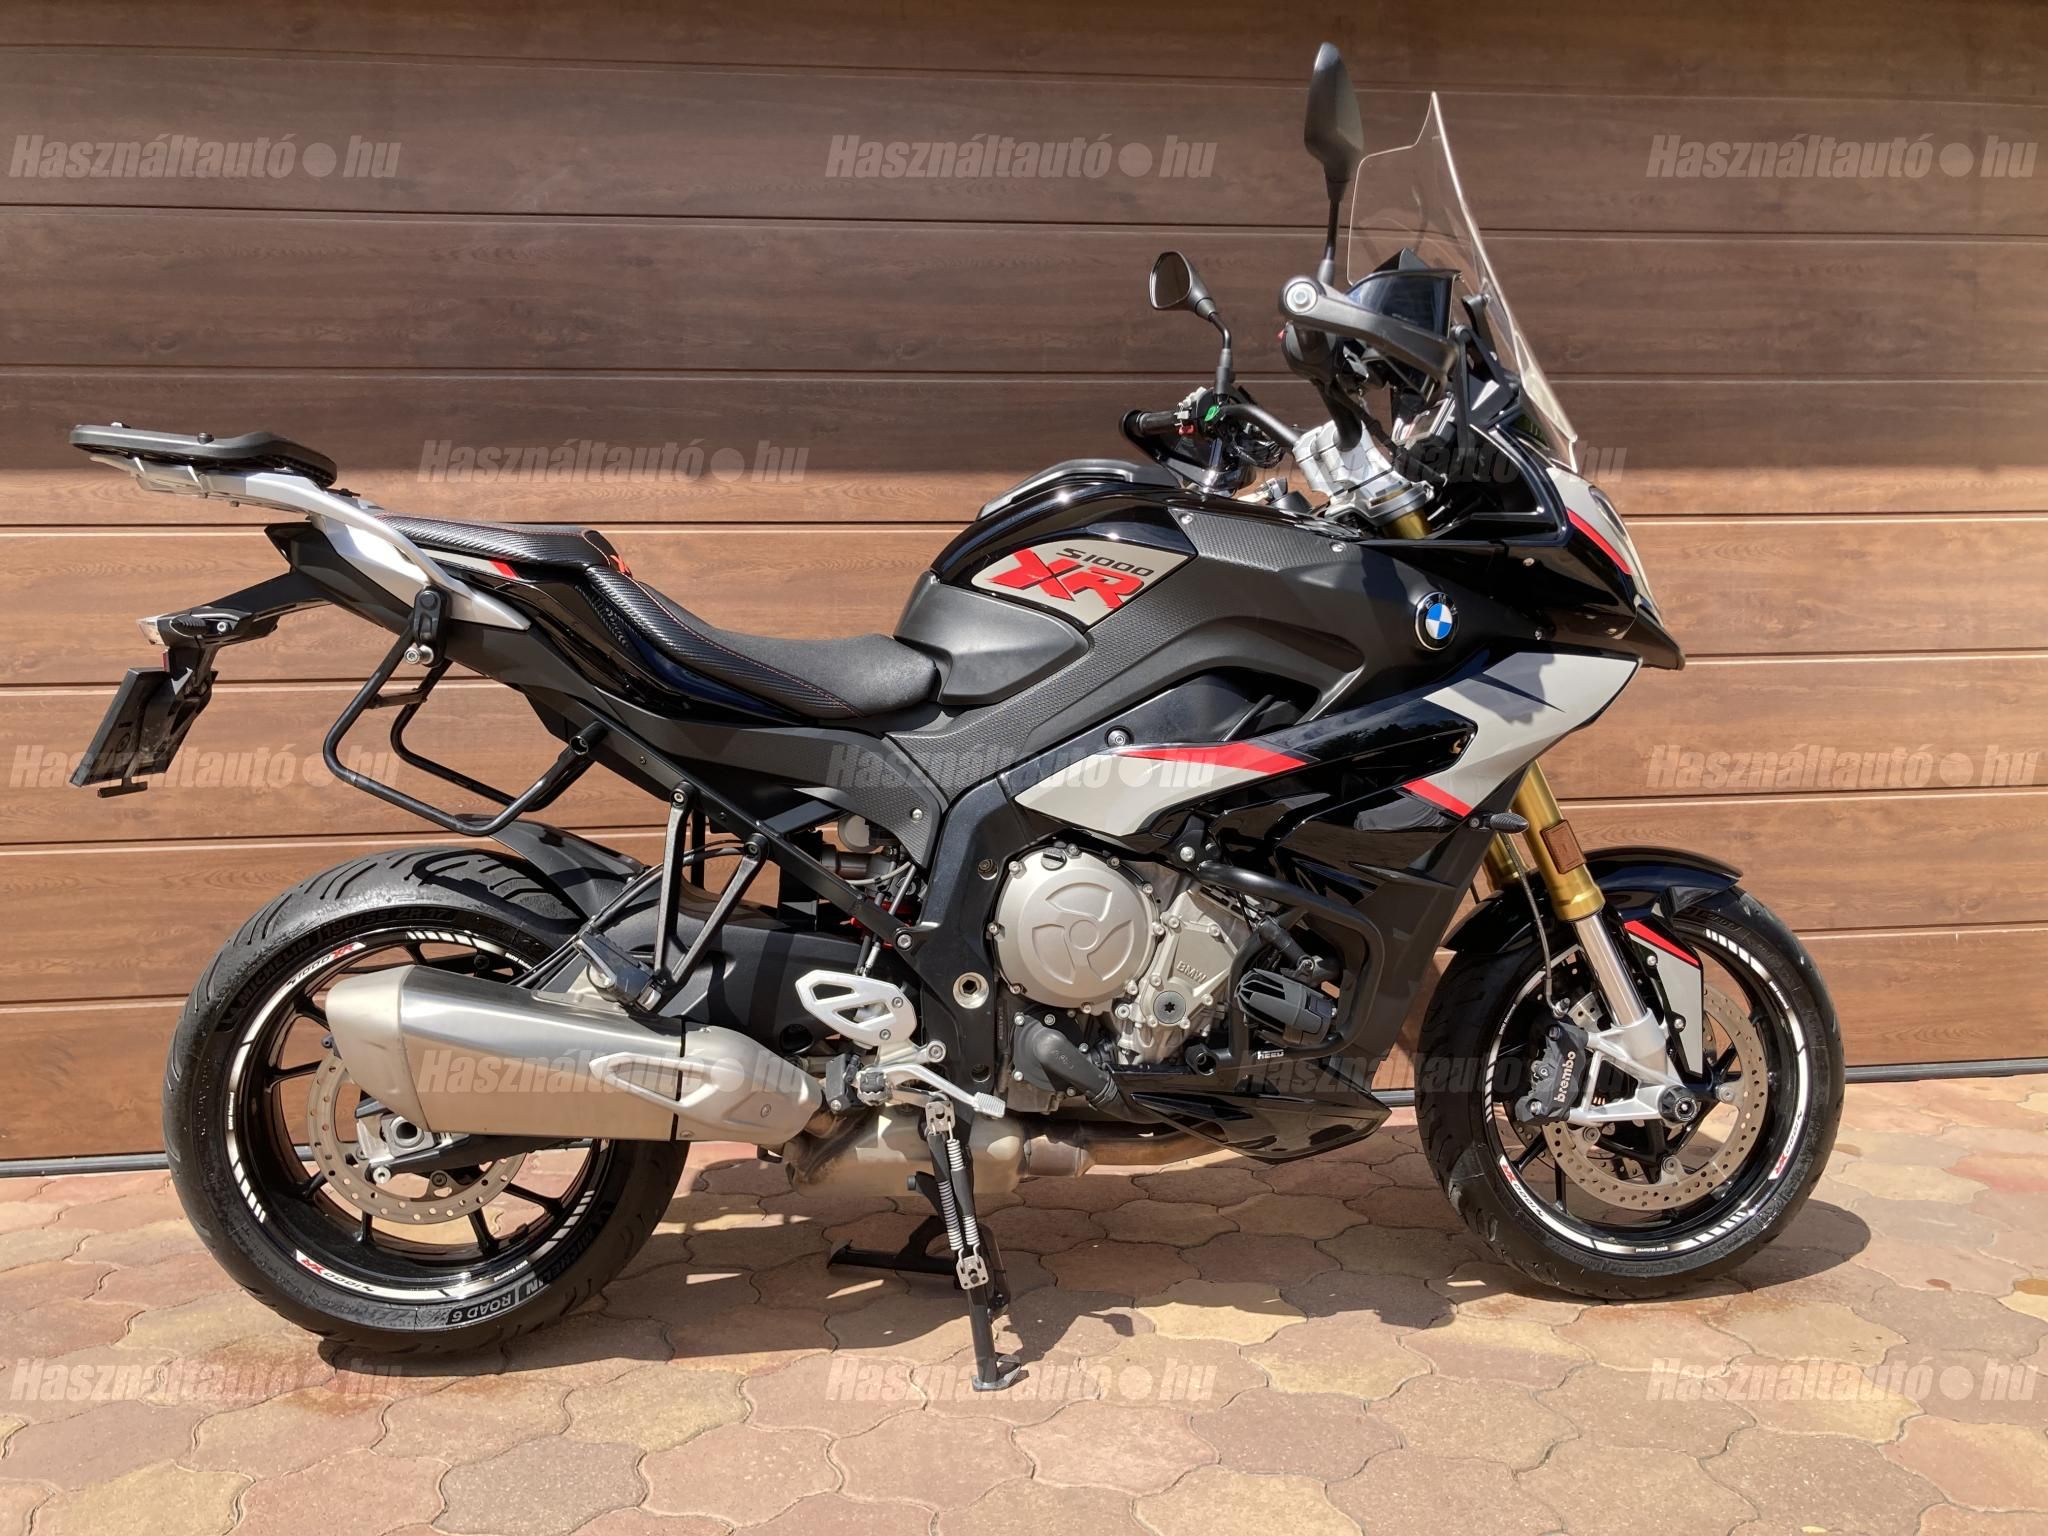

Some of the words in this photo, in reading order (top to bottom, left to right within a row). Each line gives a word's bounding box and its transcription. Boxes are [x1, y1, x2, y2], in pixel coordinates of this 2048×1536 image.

[1056, 548, 1154, 577] S1000
[985, 548, 1145, 610] XR
[240, 938, 312, 1006] MICHELIN
[1176, 960, 1207, 983] BMW
[1553, 1051, 1577, 1103] brembo
[451, 1310, 464, 1323] 6
[466, 1293, 512, 1318] ROAD
